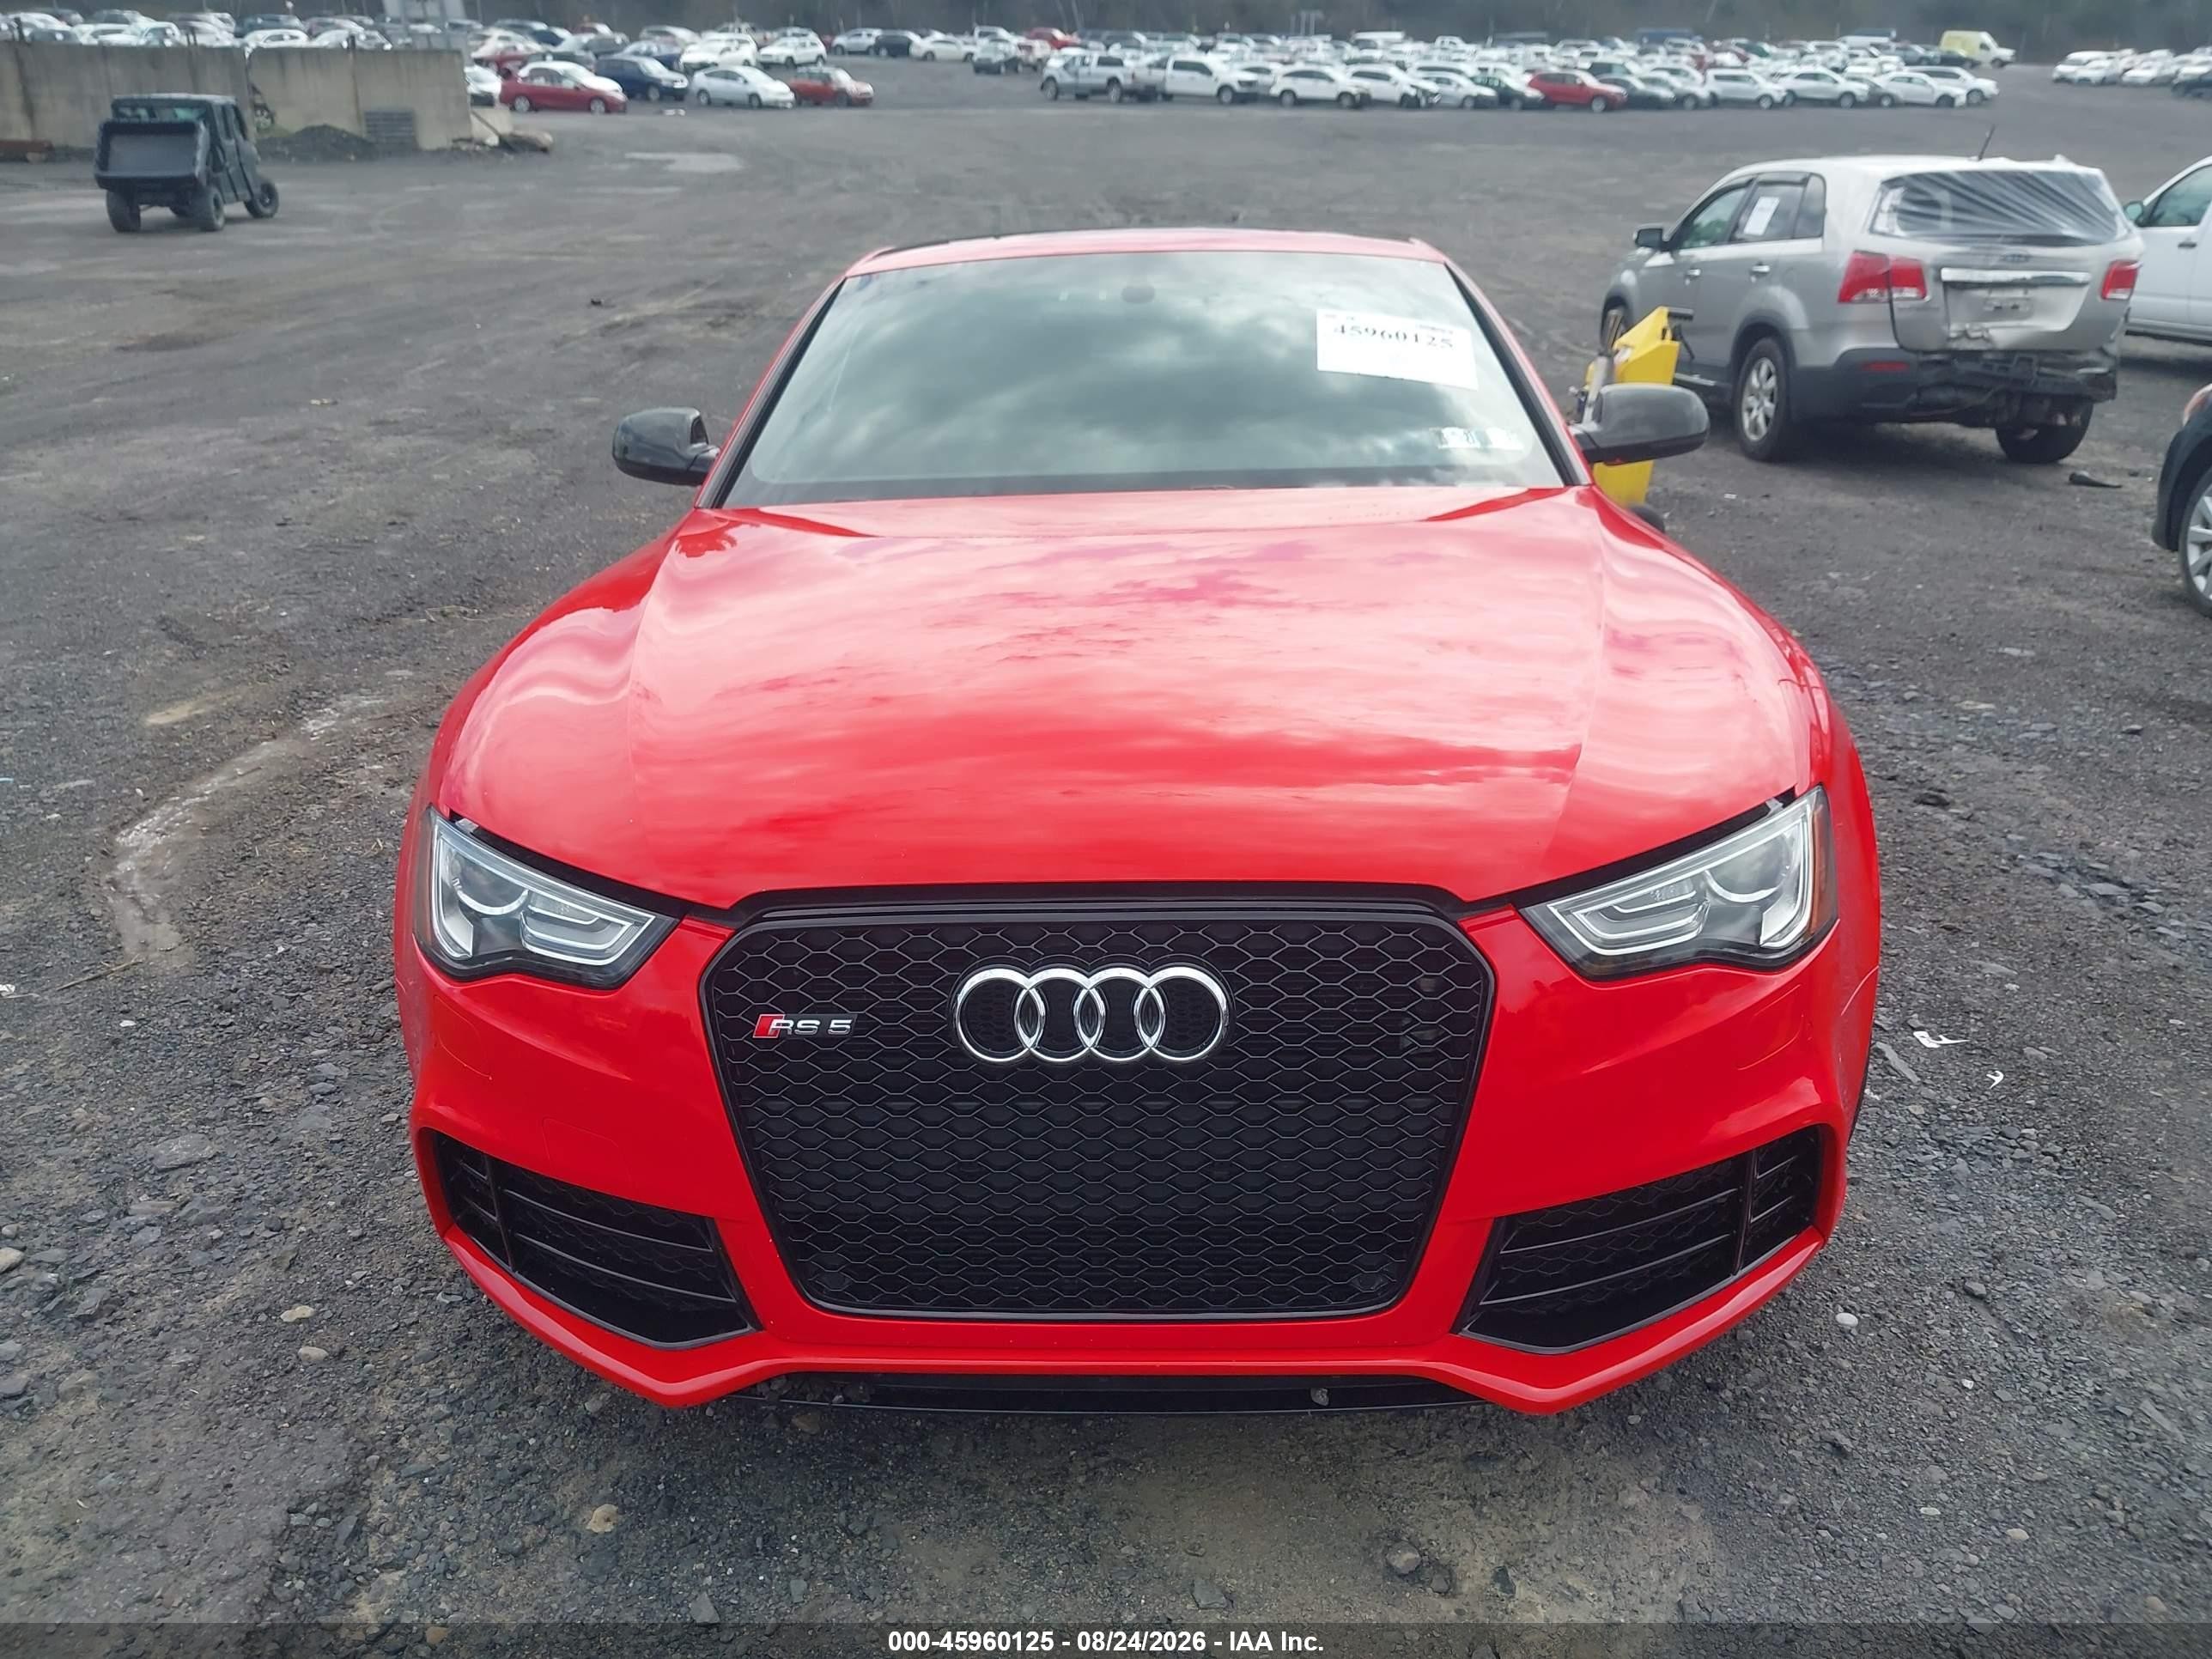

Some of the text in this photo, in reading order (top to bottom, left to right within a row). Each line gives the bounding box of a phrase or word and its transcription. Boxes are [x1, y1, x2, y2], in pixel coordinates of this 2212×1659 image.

[1333, 324, 1455, 349] 45960125
[769, 1019, 853, 1036] RS 5
